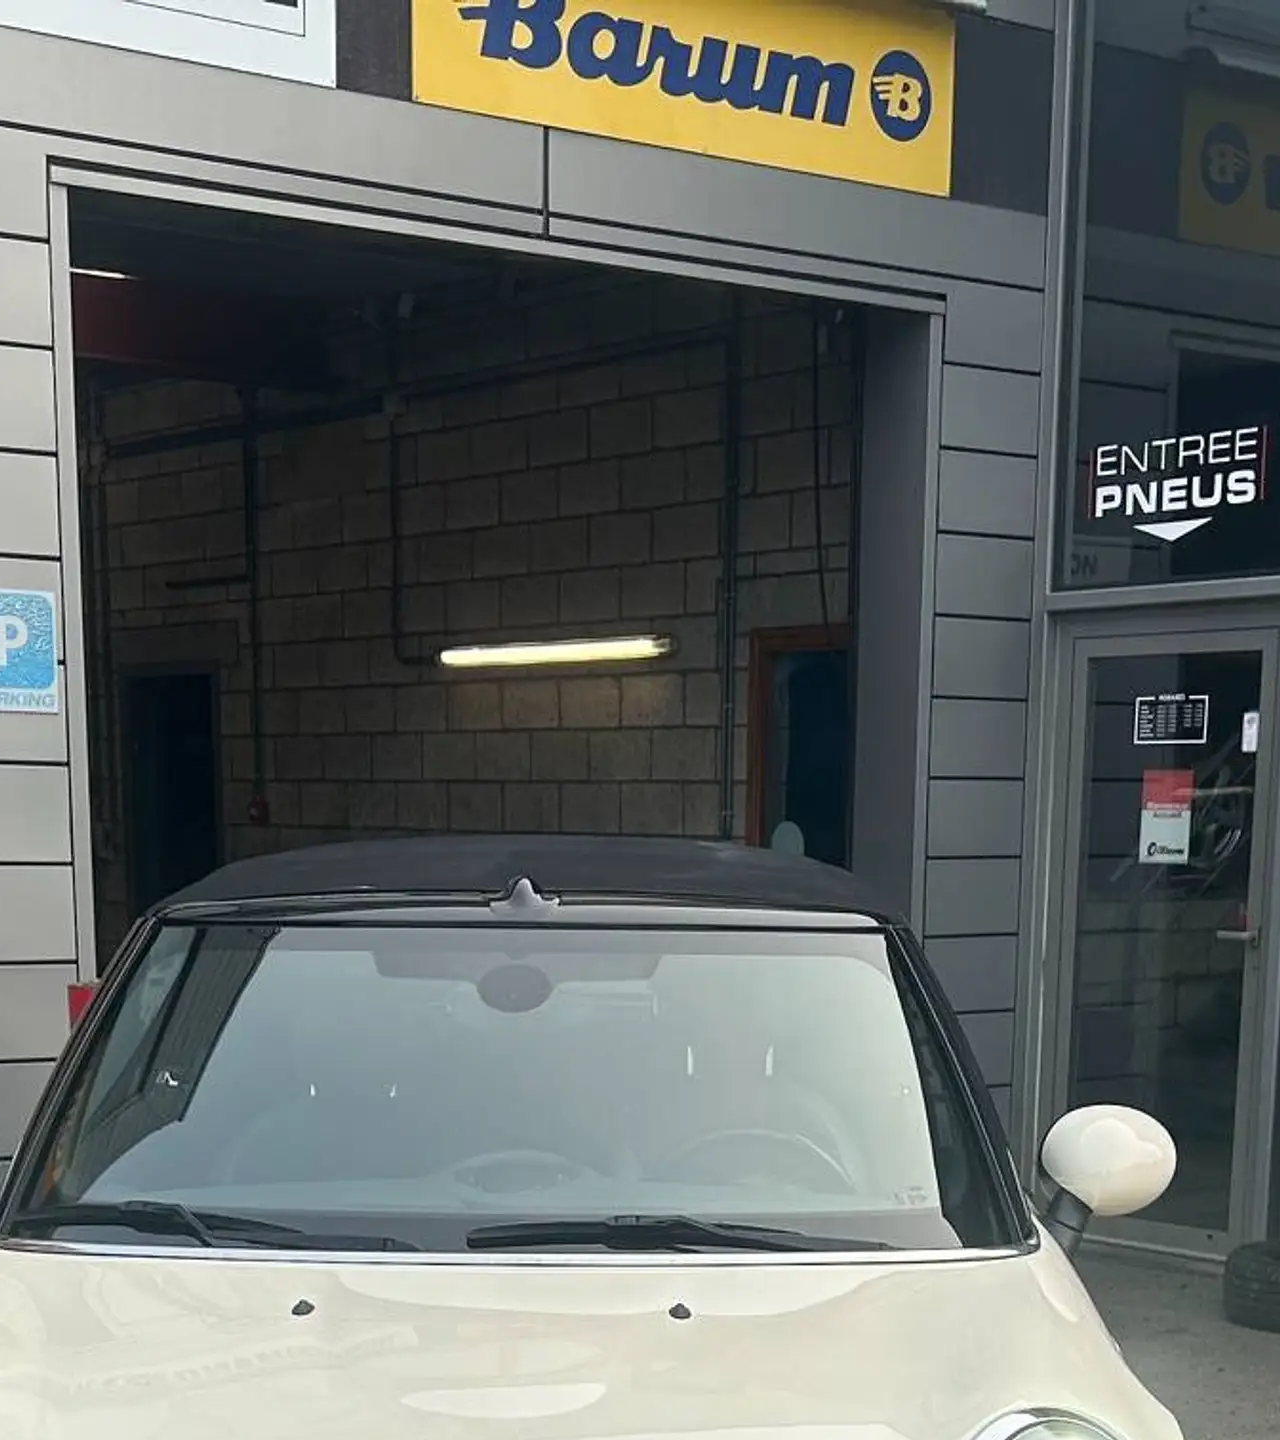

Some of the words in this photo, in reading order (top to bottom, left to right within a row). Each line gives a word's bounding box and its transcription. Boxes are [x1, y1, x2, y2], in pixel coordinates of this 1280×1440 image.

[458, 0, 855, 127] Barum
[1096, 427, 1259, 477] ENTREE
[1094, 470, 1257, 518] PNEUS
